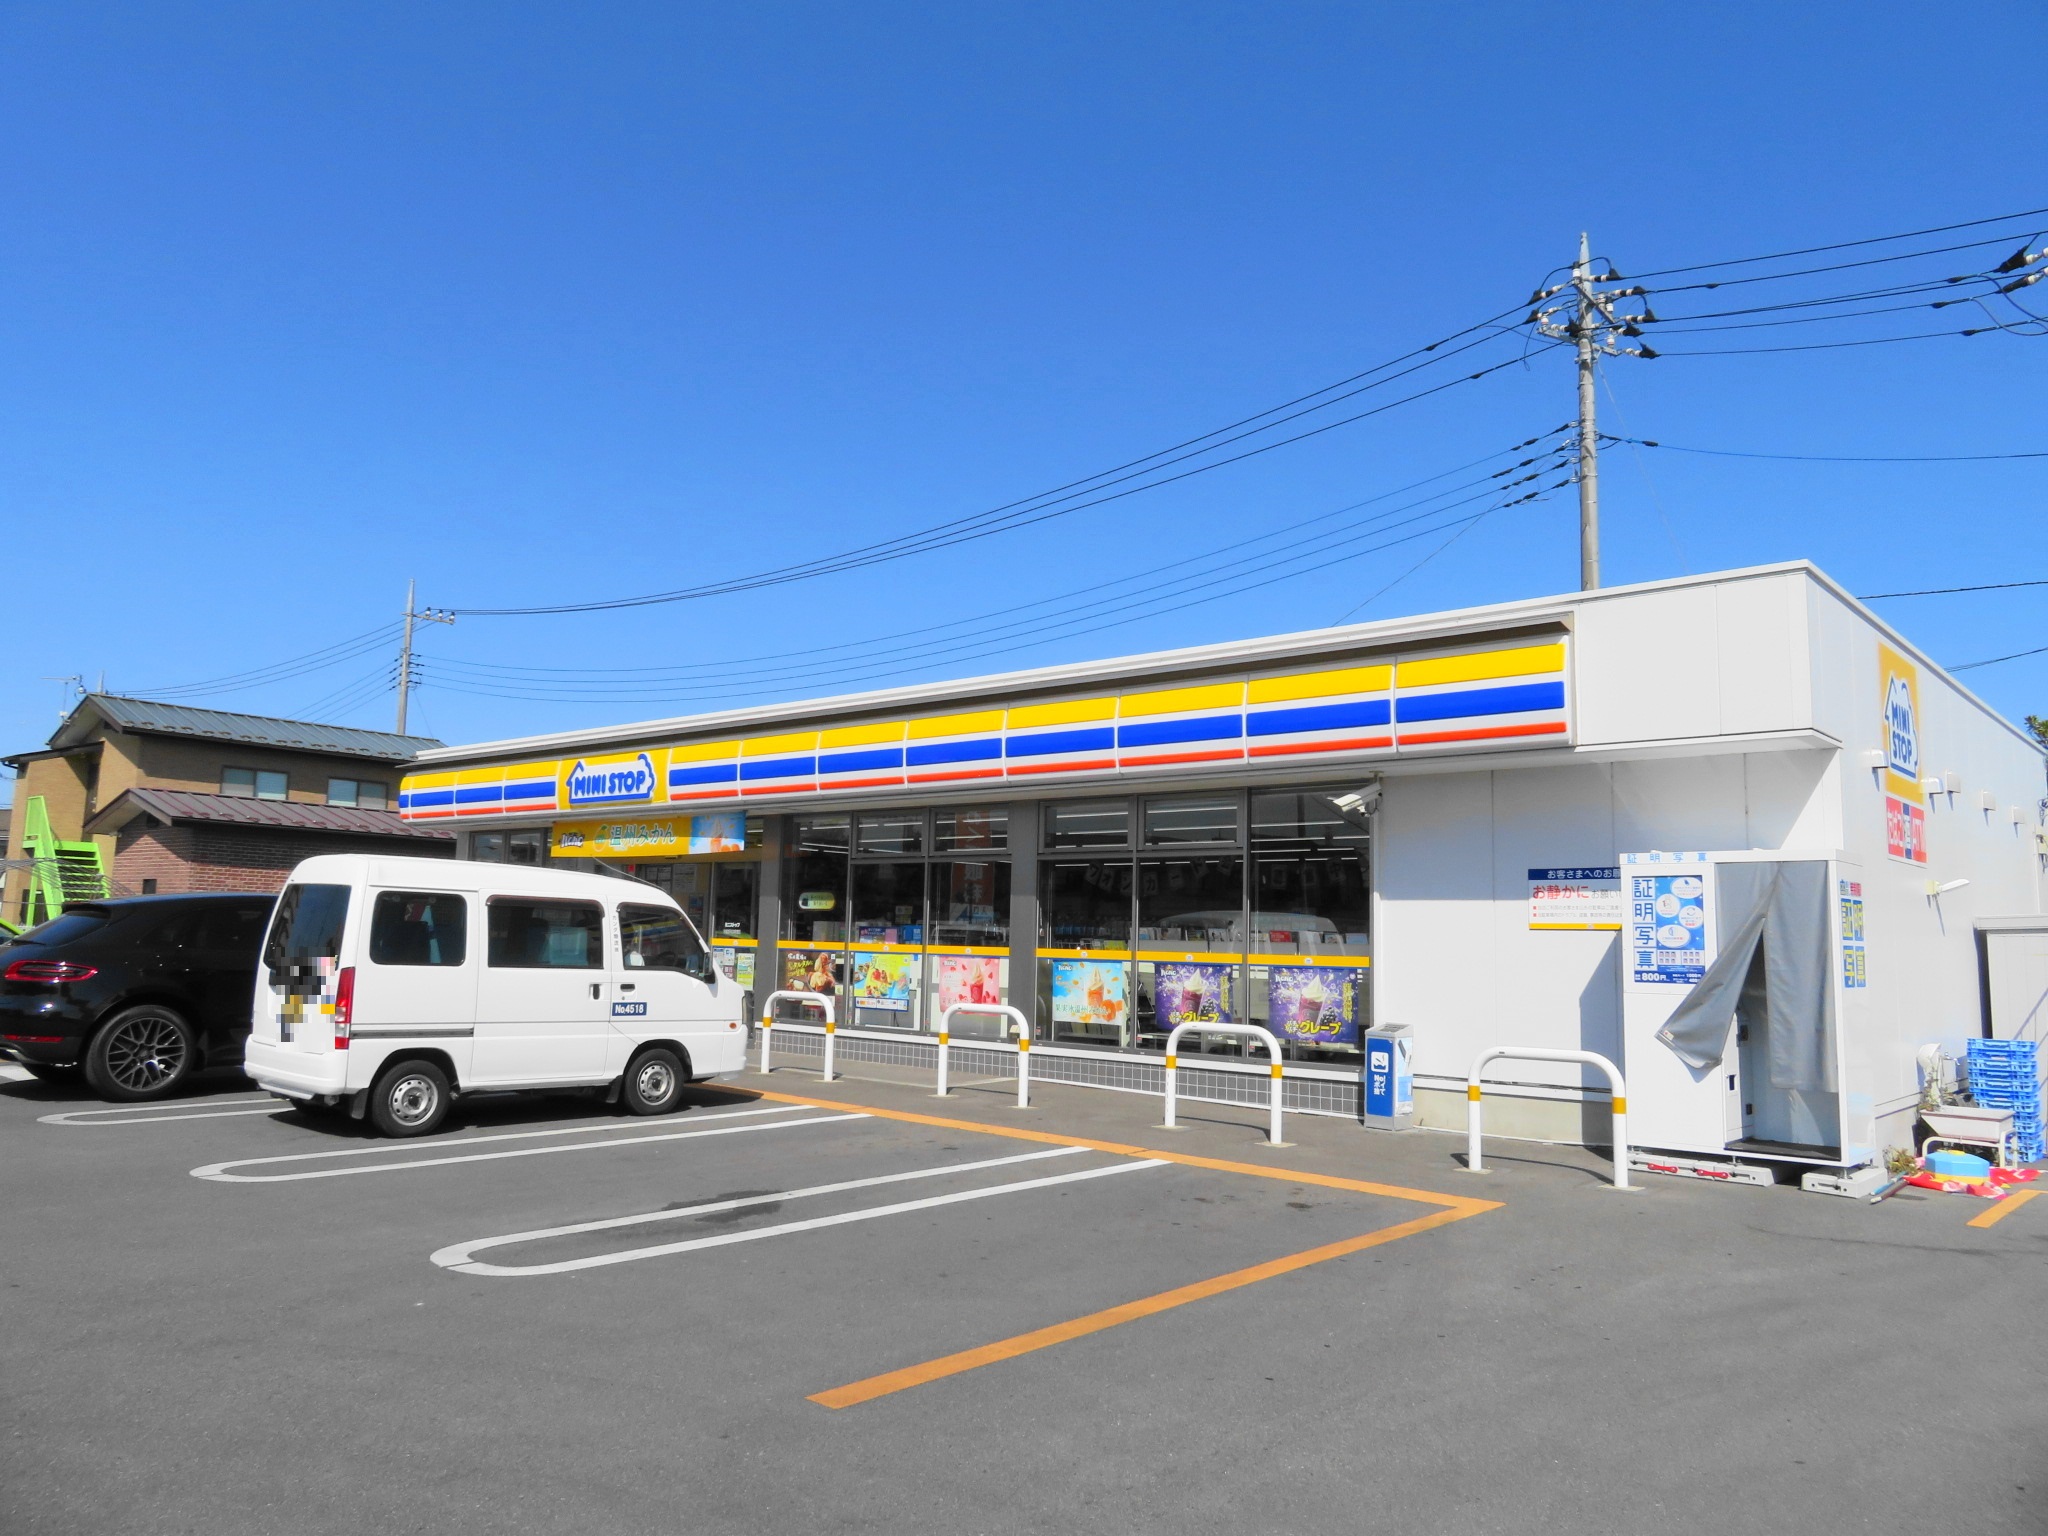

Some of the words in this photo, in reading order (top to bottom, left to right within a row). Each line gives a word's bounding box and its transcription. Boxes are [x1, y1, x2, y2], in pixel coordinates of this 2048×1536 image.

[1891, 700, 1911, 735] MINI
[1892, 730, 1913, 765] STOP
[573, 774, 607, 797] MINI
[608, 770, 647, 795] STOP
[609, 822, 677, 847] 温州みかん
[1626, 852, 1708, 864] 証明写真
[1532, 884, 1590, 900] お静かに
[1591, 889, 1622, 900] お願い
[1633, 879, 1655, 969] 証明写真
[1182, 1011, 1220, 1023] グレープ
[1299, 1020, 1342, 1035] グレープ
